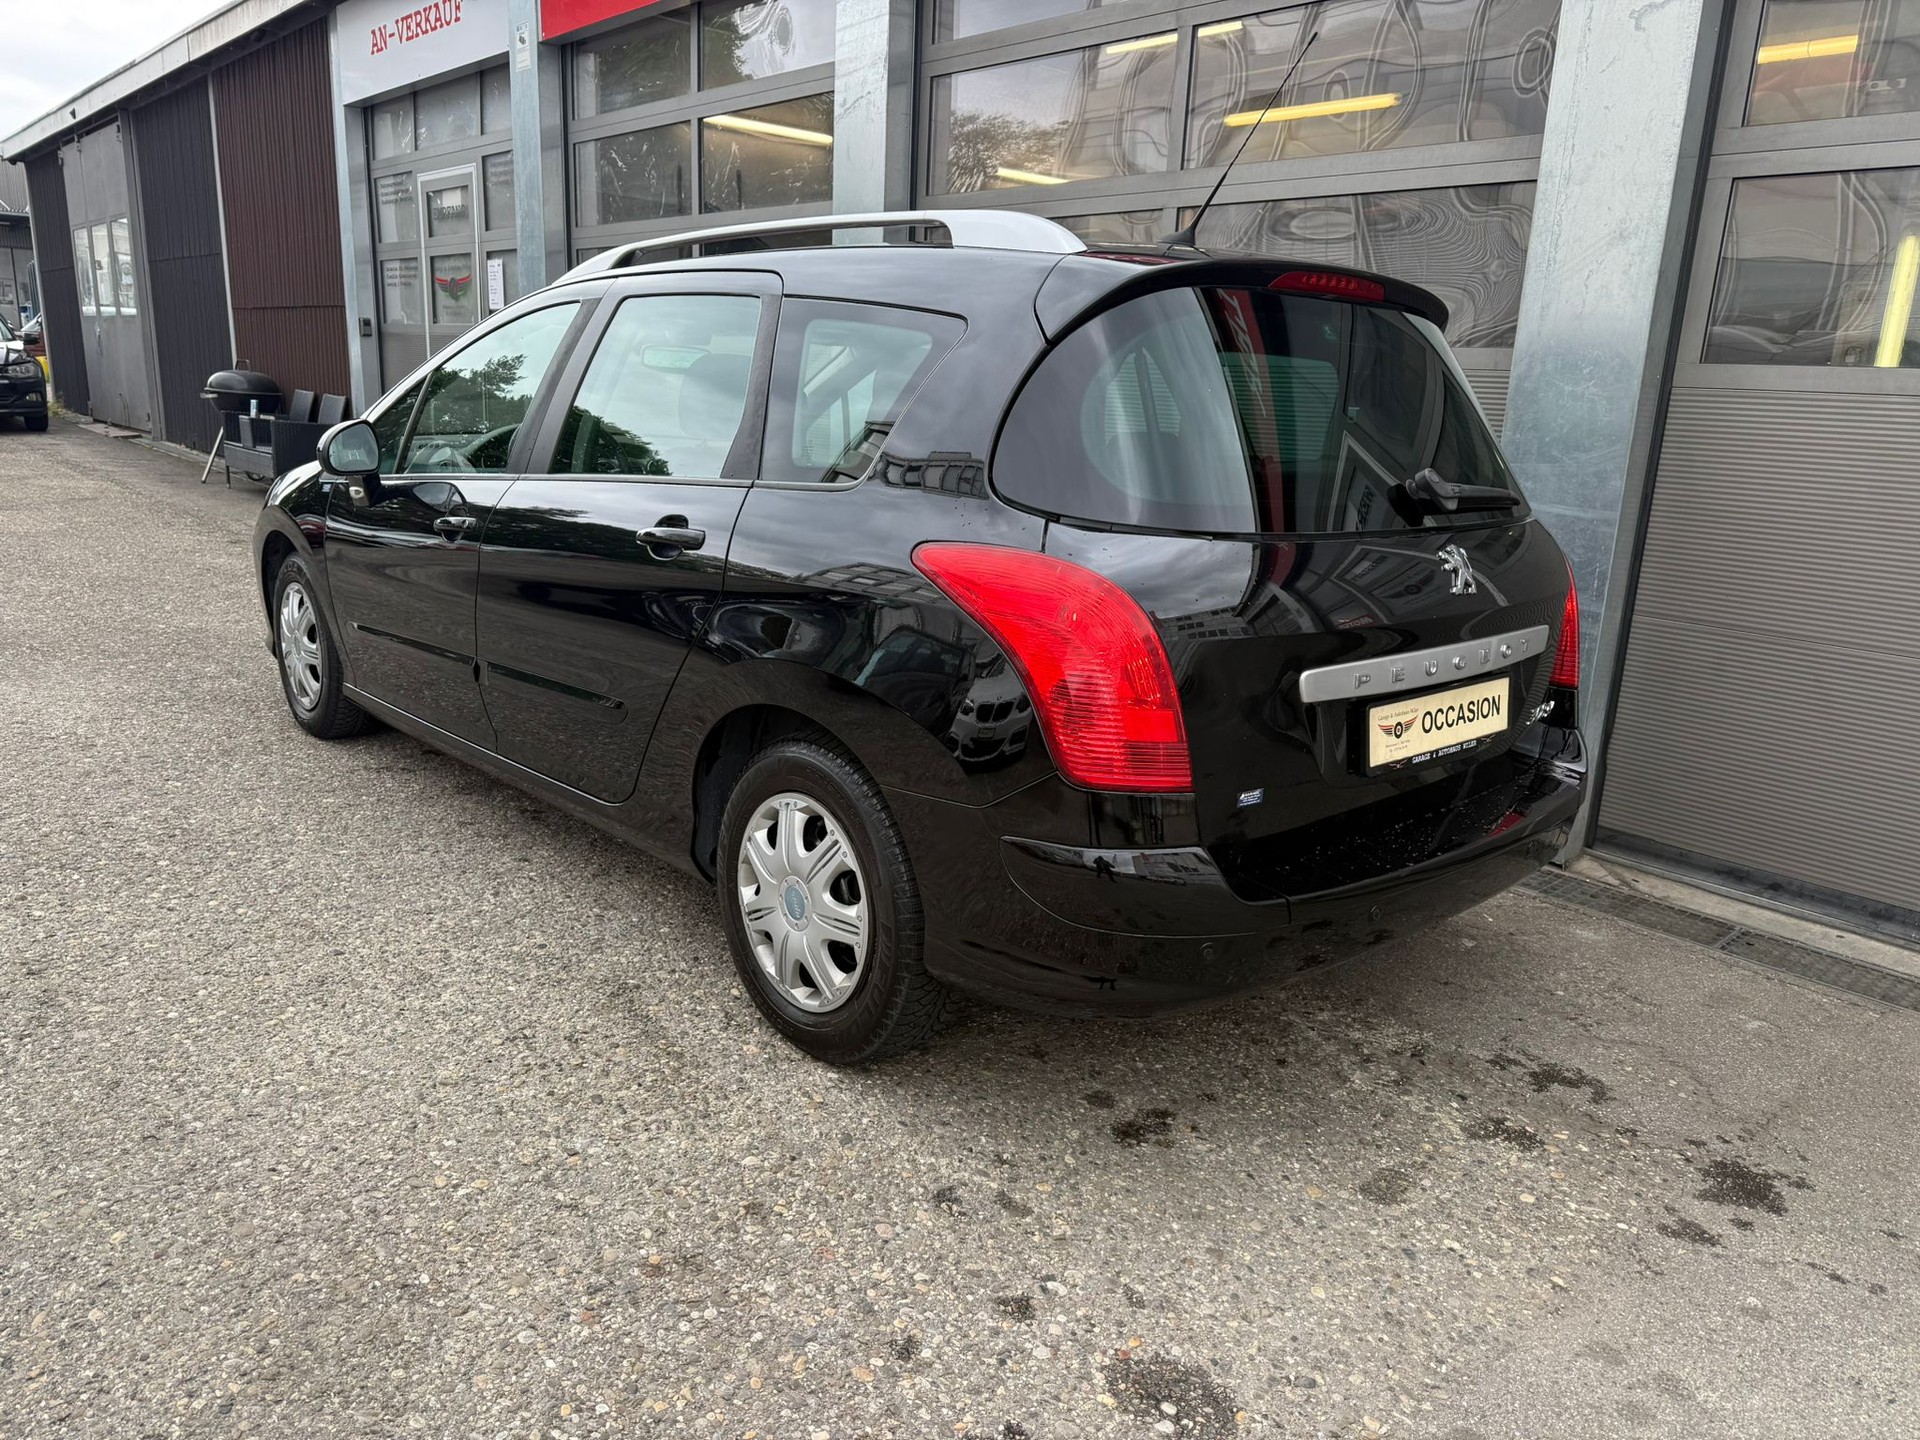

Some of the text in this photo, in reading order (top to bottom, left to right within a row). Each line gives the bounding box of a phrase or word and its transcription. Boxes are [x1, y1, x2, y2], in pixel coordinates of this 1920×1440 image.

[371, 0, 463, 55] AN-VERKAUF
[1354, 638, 1529, 689] PEUGEOT
[1422, 695, 1501, 734] OCCASION
[1412, 753, 1431, 764] GARAGE
